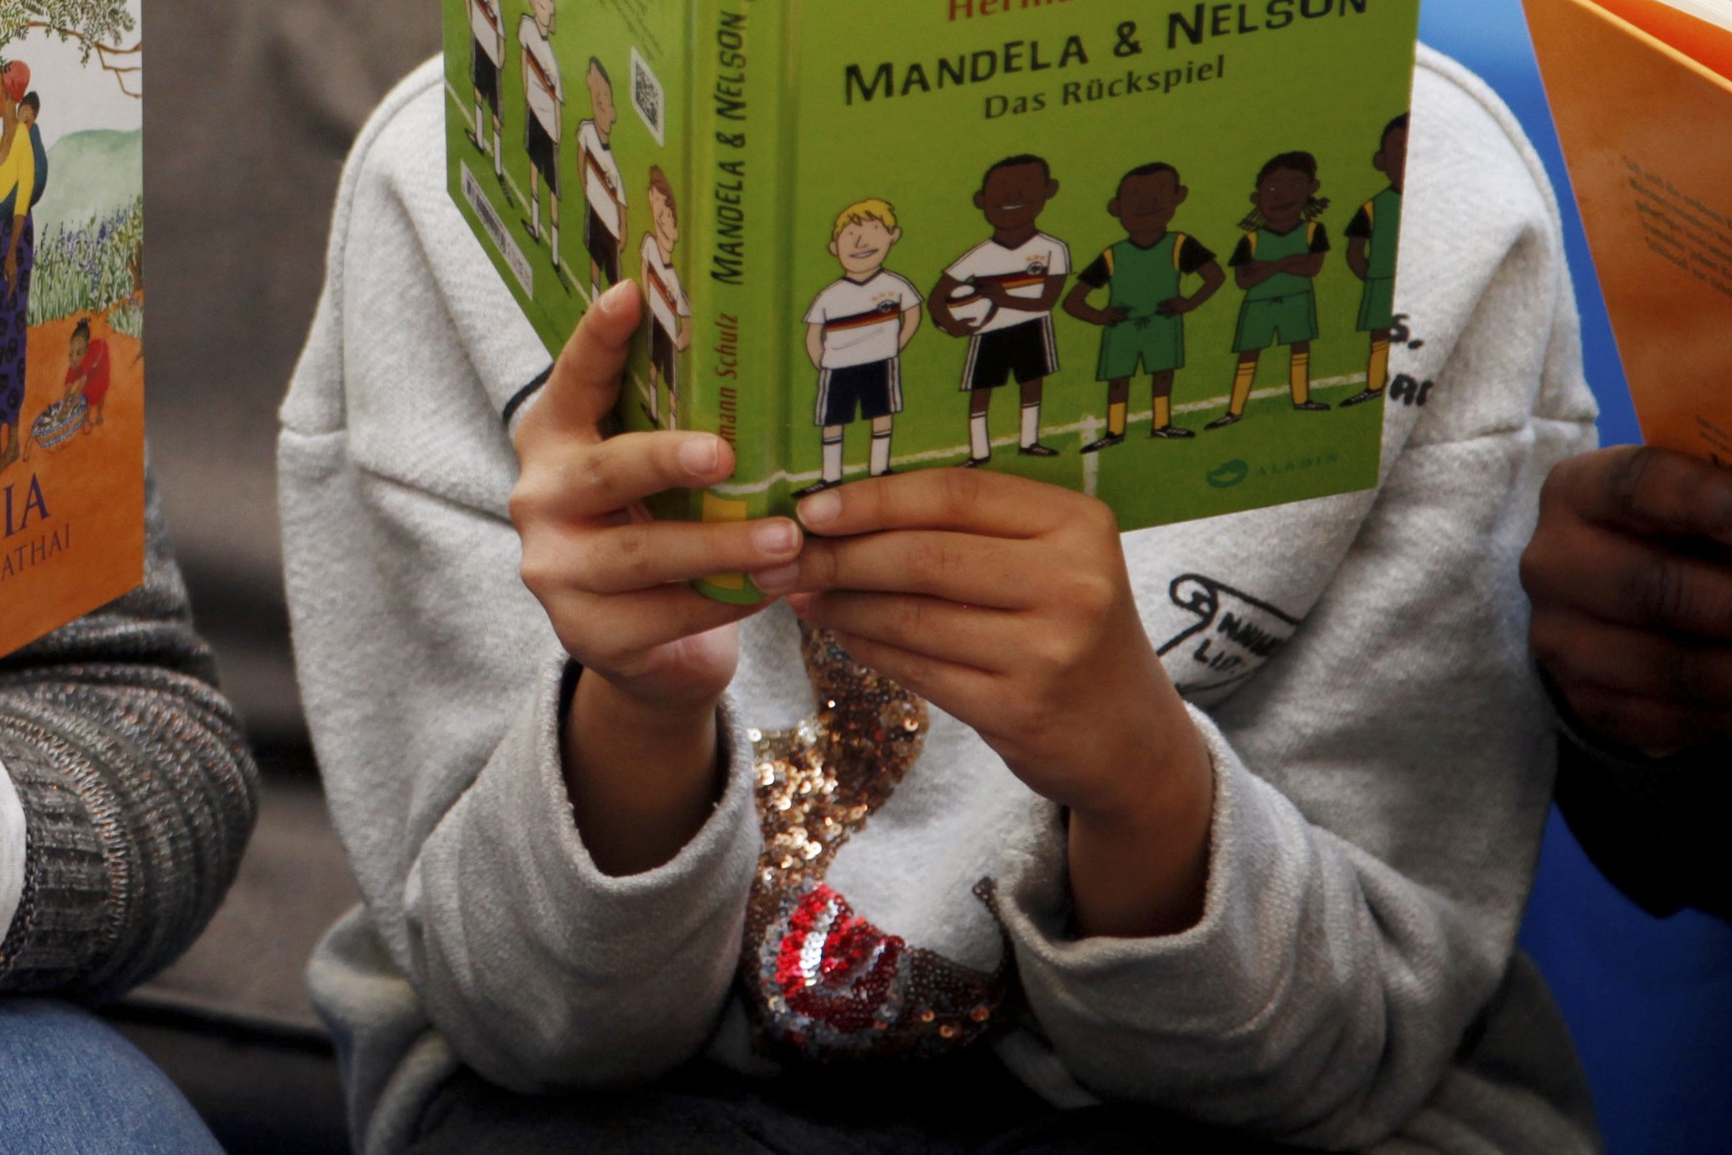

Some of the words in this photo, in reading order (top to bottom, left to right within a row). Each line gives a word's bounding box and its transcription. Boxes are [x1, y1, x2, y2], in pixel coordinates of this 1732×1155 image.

[713, 11, 746, 121] NELSON
[845, 34, 1089, 105] MANDELA
[1112, 20, 1143, 58] &
[984, 91, 1046, 120] Das
[1062, 54, 1225, 106] Rückspiel
[716, 132, 746, 149] &
[710, 161, 746, 286] MANDELA
[715, 313, 739, 379] Schulz
[718, 386, 738, 449] mann
